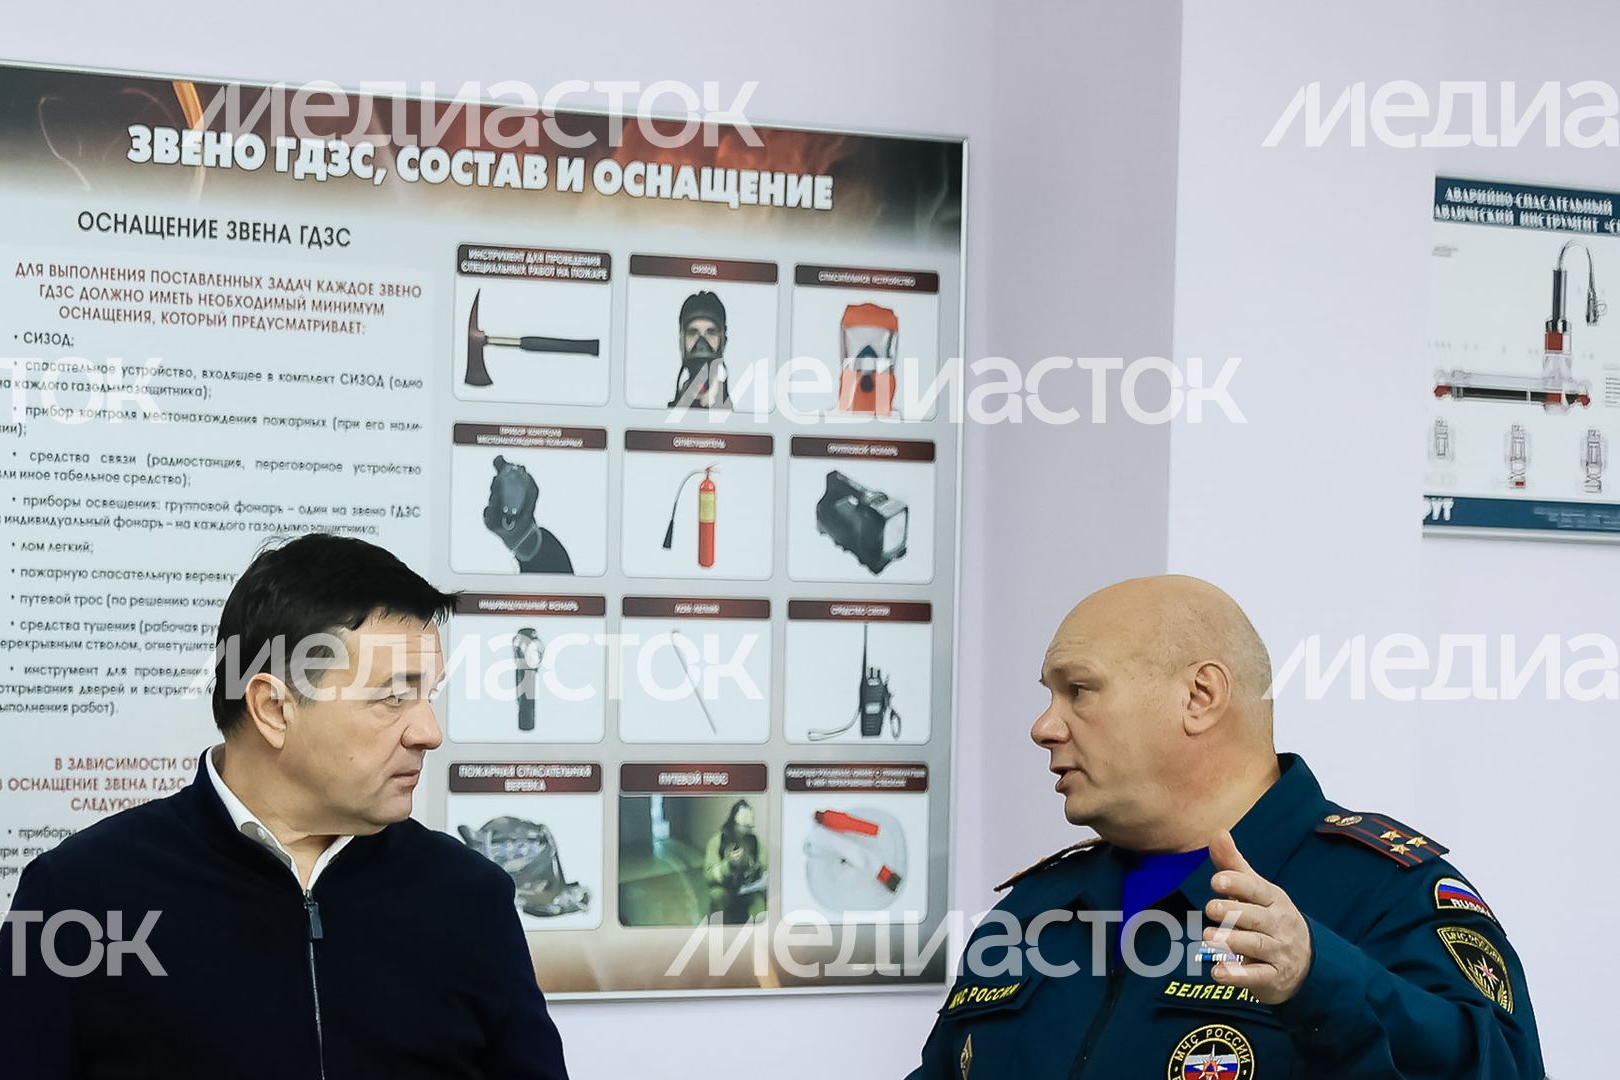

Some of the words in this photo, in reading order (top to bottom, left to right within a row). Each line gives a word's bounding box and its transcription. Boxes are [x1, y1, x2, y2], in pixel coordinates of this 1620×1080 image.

[126, 123, 267, 173] ЗВЕНО
[275, 134, 388, 186] ГДЗС,
[396, 144, 549, 191] СОСТАВ
[556, 157, 586, 194] И
[592, 159, 835, 210] ОСНАЩЕНИЕ
[76, 210, 219, 240] ОСНАЩЕНИЕ
[225, 219, 292, 244] ЗВЕНА
[299, 224, 351, 251] ГДЗС
[14, 261, 44, 279] ДЛЯ
[48, 263, 146, 283] ВЫПОЛНЕНИЯ
[149, 269, 264, 289] ПОСТАВЛЕННЫХ
[267, 276, 312, 293] ЗАДАЧ
[315, 279, 374, 297] КАЖДОЕ
[378, 283, 422, 298] ЗВЕНО
[38, 283, 75, 301] ГДЗС
[78, 285, 145, 305] ДОЛЖНО
[148, 289, 194, 306] ИМЕТЬ
[197, 291, 307, 312] НЕОБХОДИМЫЙ
[159, 308, 228, 328] КОТОРЫЙ
[53, 757, 64, 771] В
[66, 756, 178, 771] ЗАВИСИМОСТИ
[182, 757, 198, 770] ОТ
[1164, 981, 1235, 1000] БЕЛЯЕВ
[1174, 1034, 1199, 1062] МЧС
[1206, 1028, 1251, 1064] РОССИИ
